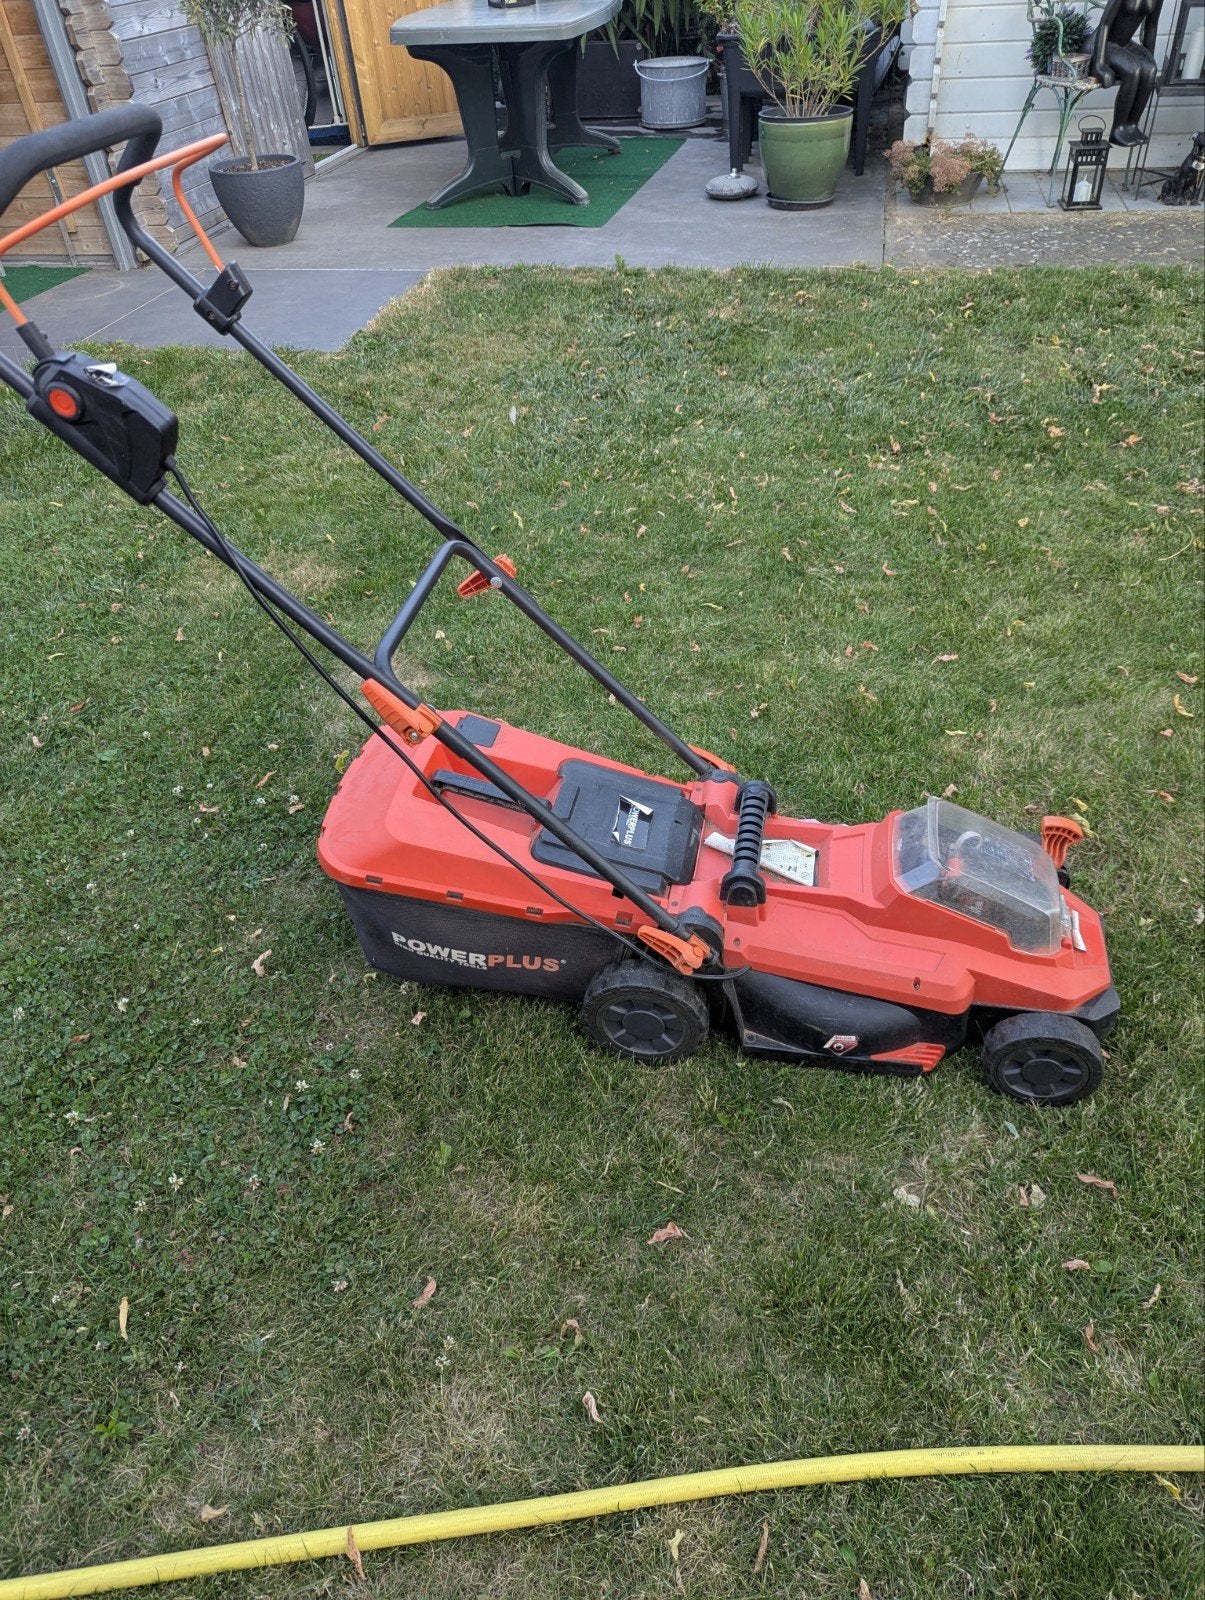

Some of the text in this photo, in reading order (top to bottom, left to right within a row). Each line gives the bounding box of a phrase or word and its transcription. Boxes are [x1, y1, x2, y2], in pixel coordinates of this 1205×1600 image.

[623, 806, 640, 845] OWERPLUS
[416, 951, 455, 963] QUALITY
[459, 962, 487, 970] TOOLS
